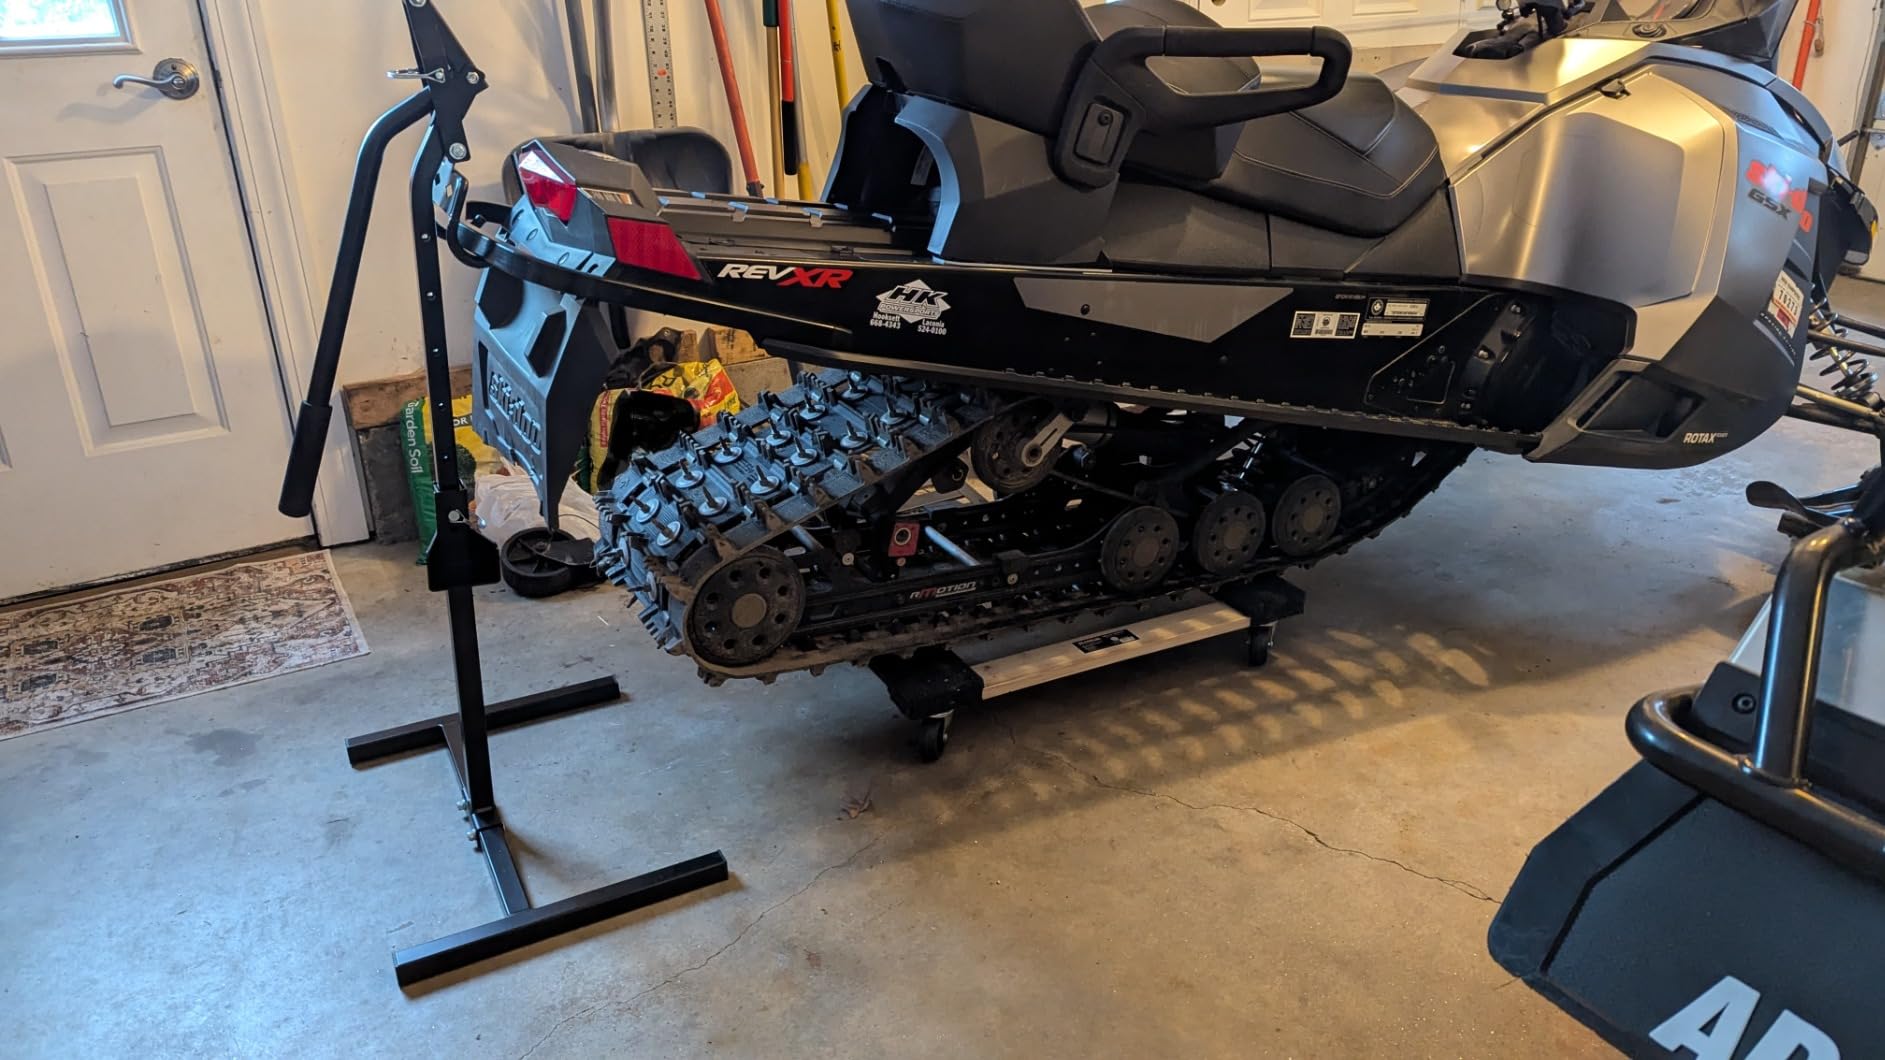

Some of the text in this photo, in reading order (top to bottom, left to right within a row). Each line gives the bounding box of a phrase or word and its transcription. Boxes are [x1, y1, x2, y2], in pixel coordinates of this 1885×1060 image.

[1748, 188, 1791, 220] GSX
[888, 286, 946, 305] HK
[1683, 432, 1716, 444] ROTAX
[408, 448, 424, 474] Soil
